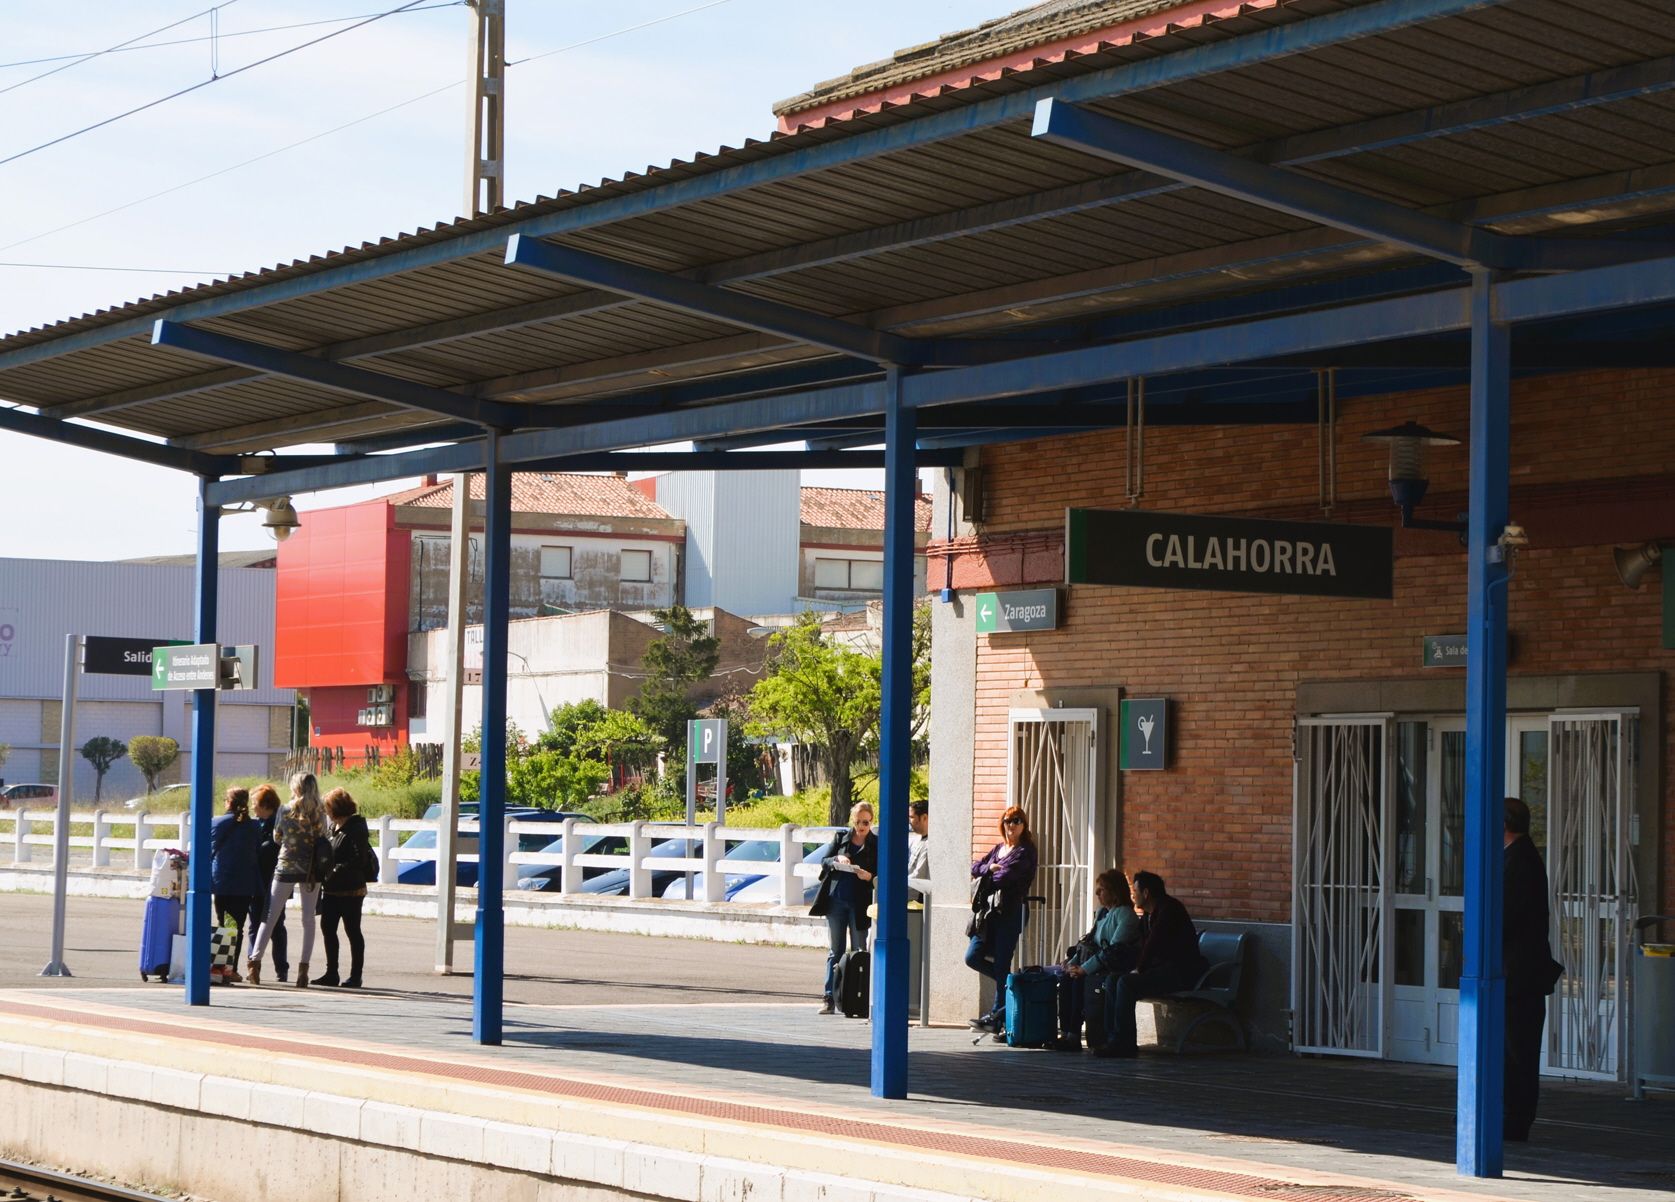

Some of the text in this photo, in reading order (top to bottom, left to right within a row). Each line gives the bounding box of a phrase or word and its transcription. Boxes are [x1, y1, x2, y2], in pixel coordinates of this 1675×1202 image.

[1145, 533, 1337, 577] CALAHORRA
[1004, 603, 1047, 623] Zaragoza
[123, 650, 153, 663] Salid
[1445, 645, 1459, 656] Sala
[704, 728, 713, 754] P
